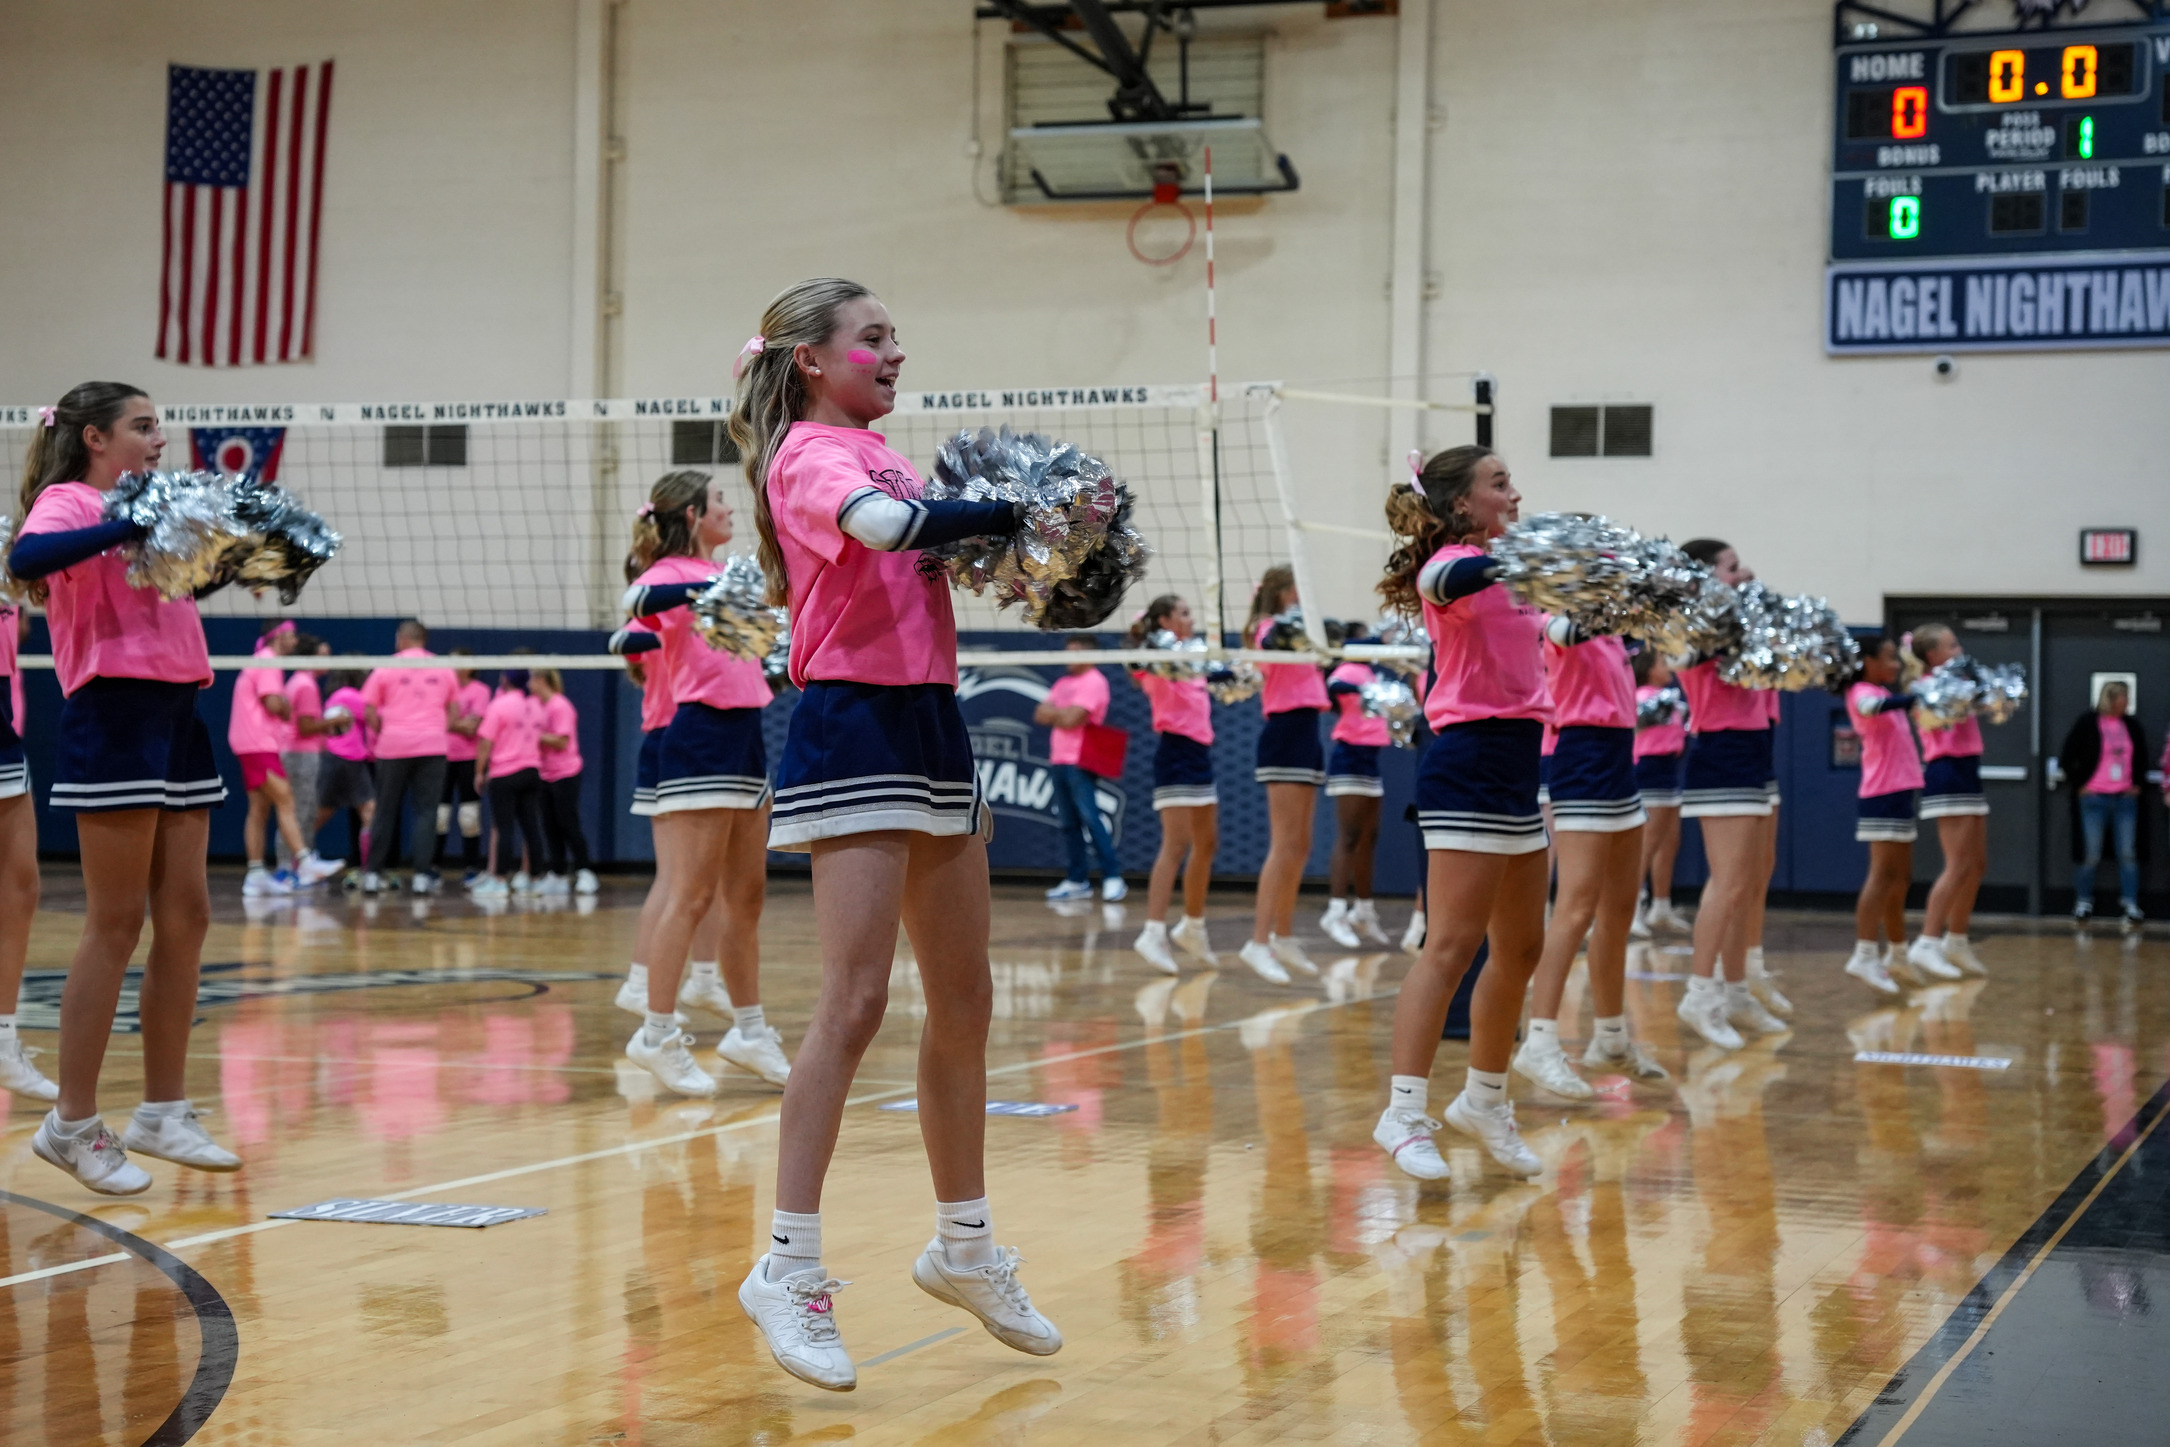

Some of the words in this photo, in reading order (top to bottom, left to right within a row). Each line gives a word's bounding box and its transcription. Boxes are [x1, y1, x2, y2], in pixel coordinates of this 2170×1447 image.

[1851, 52, 1925, 82] HOME
[1988, 45, 2098, 103] 0.0
[1892, 86, 1928, 139] 0
[1986, 126, 2056, 149] PERIOD
[2079, 116, 2094, 159] 1
[1877, 144, 1941, 167] BONUS
[1864, 175, 1923, 198] FOULS
[1975, 170, 2046, 193] PLAYER
[2059, 166, 2120, 189] FOULS
[1890, 196, 1920, 239] 0
[1837, 275, 1957, 340] NAGEL
[635, 399, 700, 415] NAGEL
[922, 392, 992, 409] NAGEL
[1002, 386, 1149, 407] NIGHTHAWKS
[164, 406, 294, 422] NIGHTHAWKS
[361, 404, 425, 420] NAGEL
[434, 401, 567, 418] NIGHTHAWKS
[287, 1200, 526, 1225] SILVER
